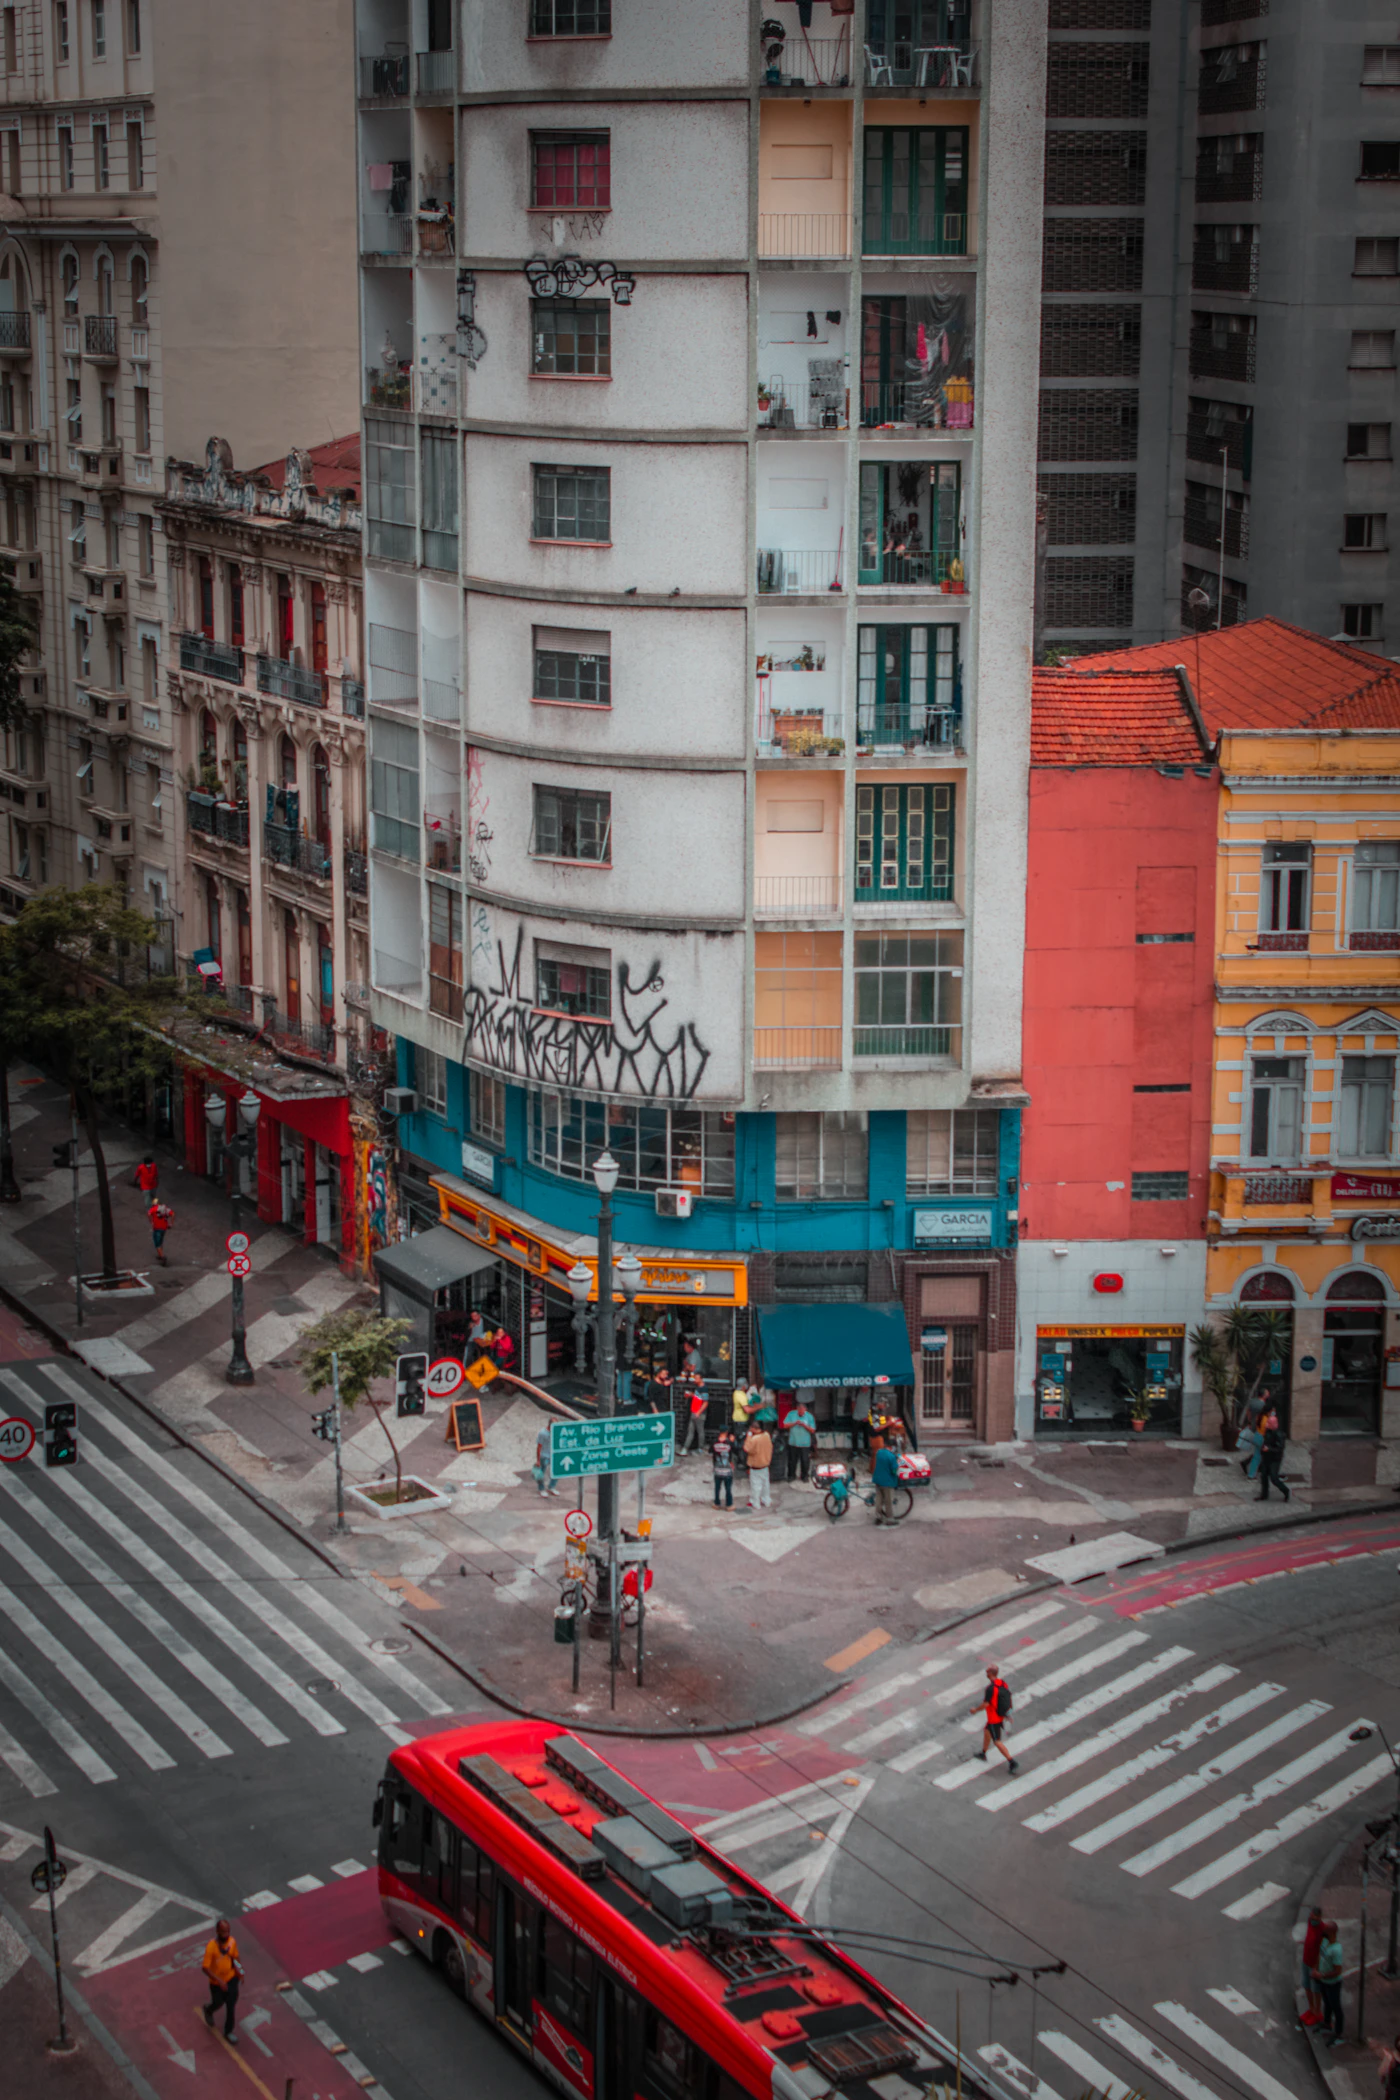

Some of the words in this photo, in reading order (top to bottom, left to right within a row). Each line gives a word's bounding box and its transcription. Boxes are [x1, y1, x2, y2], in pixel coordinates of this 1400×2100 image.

[1371, 1183, 1393, 1197] (11)
[941, 1213, 988, 1225] GARCIA
[430, 1367, 457, 1384] 40
[790, 1378, 841, 1388] CHURRASCO
[842, 1376, 872, 1386] GREGO
[0, 1426, 25, 1445] 40
[560, 1427, 577, 1437] Av.
[581, 1425, 600, 1435] Rio
[604, 1421, 645, 1434] Branco
[559, 1437, 579, 1448] Est.
[585, 1436, 599, 1446] da
[604, 1434, 625, 1445] Luz
[581, 1450, 610, 1461] Zona
[615, 1446, 648, 1458] Oeste
[580, 1462, 608, 1473] Lapa
